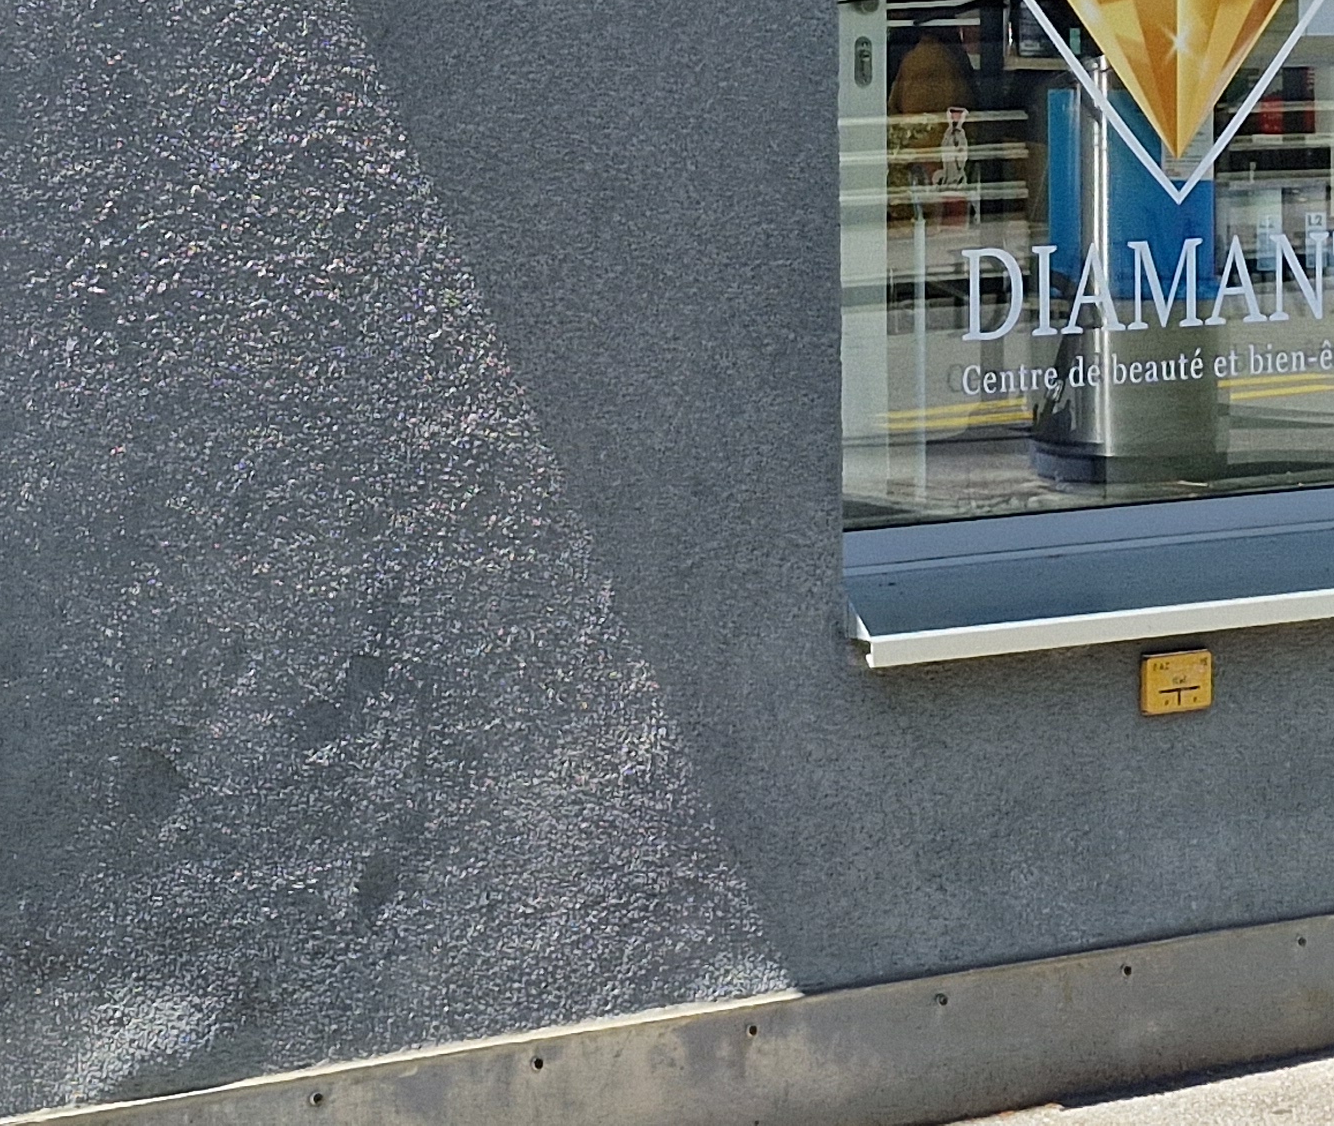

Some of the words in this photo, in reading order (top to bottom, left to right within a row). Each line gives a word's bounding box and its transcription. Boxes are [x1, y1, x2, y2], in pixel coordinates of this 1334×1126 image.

[961, 361, 1060, 396] Centre
[1068, 354, 1101, 388] de
[1111, 347, 1205, 387] beauté
[1214, 345, 1240, 377] et
